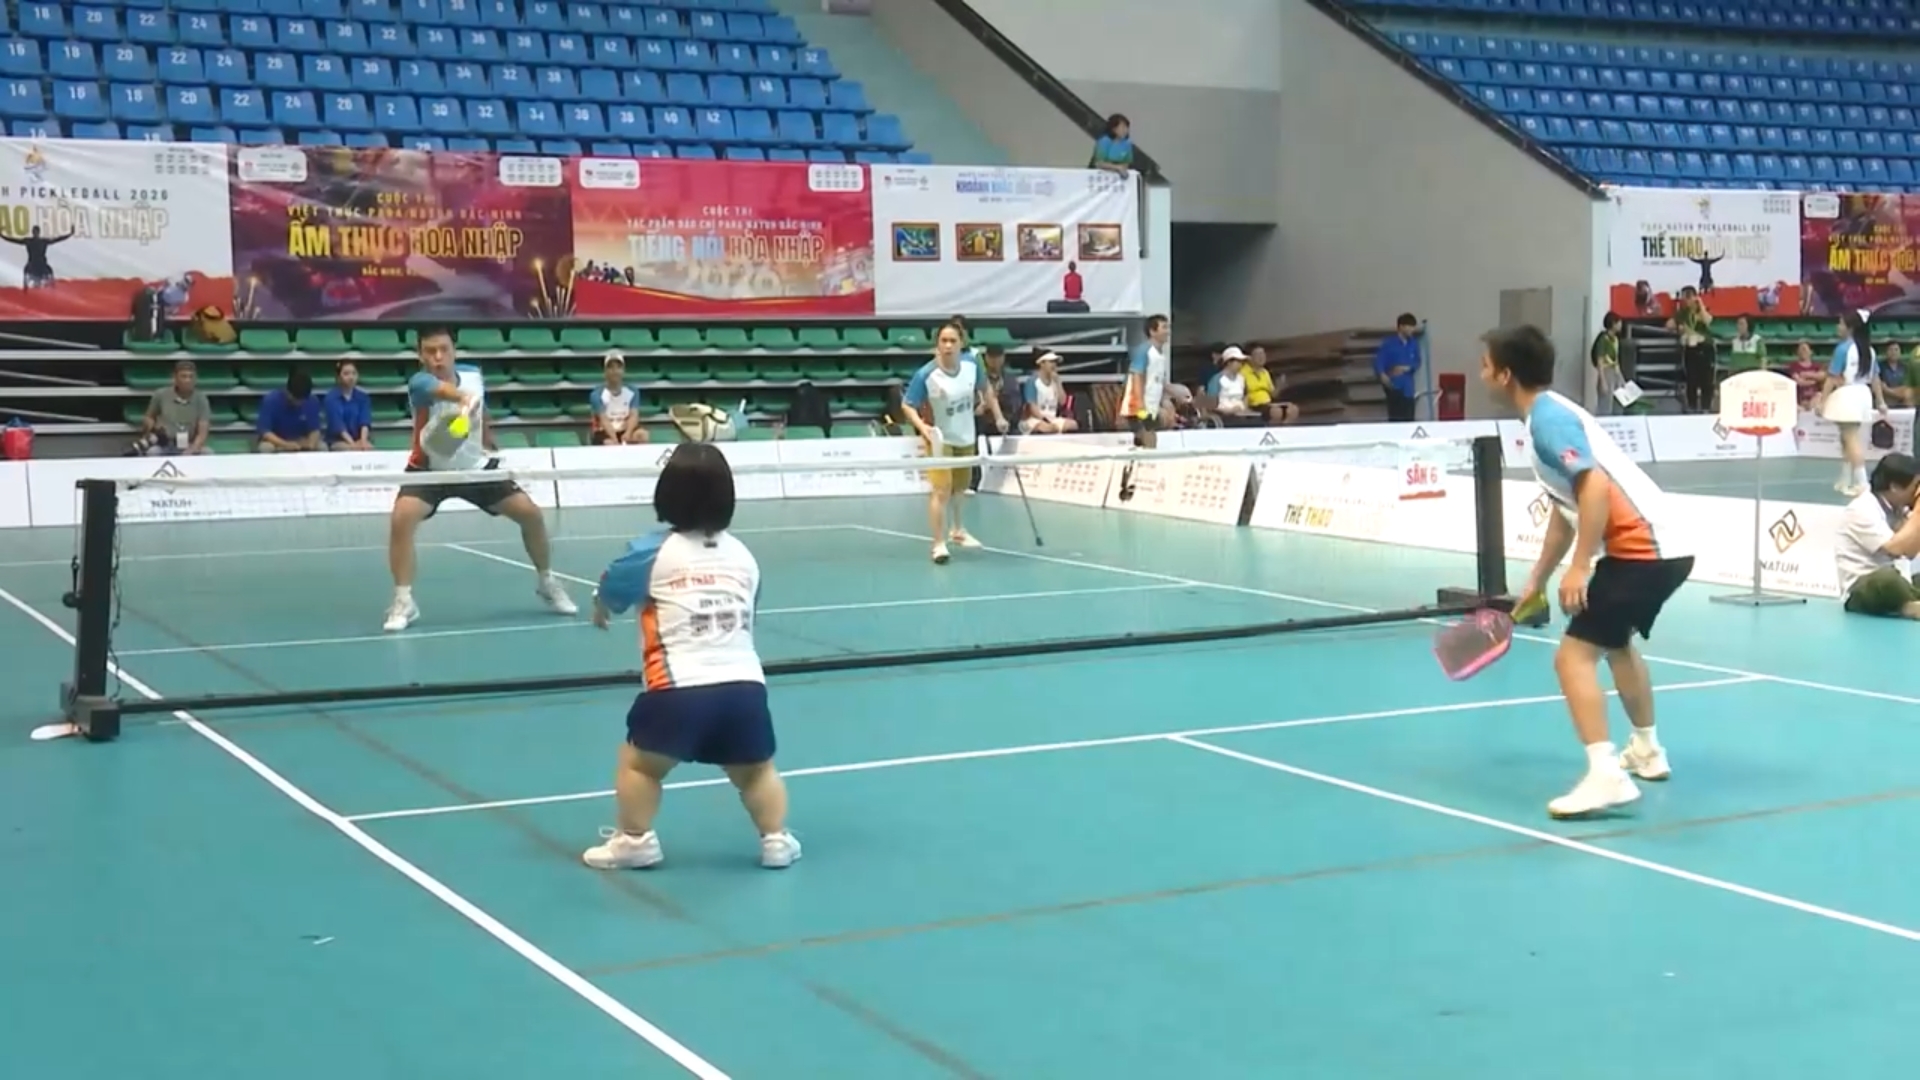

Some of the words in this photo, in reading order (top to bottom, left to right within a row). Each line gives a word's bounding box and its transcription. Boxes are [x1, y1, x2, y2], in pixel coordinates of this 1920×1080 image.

[99, 201, 169, 245] NHẬP
[462, 221, 523, 264] NHẬP
[773, 230, 825, 268] NHẬP
